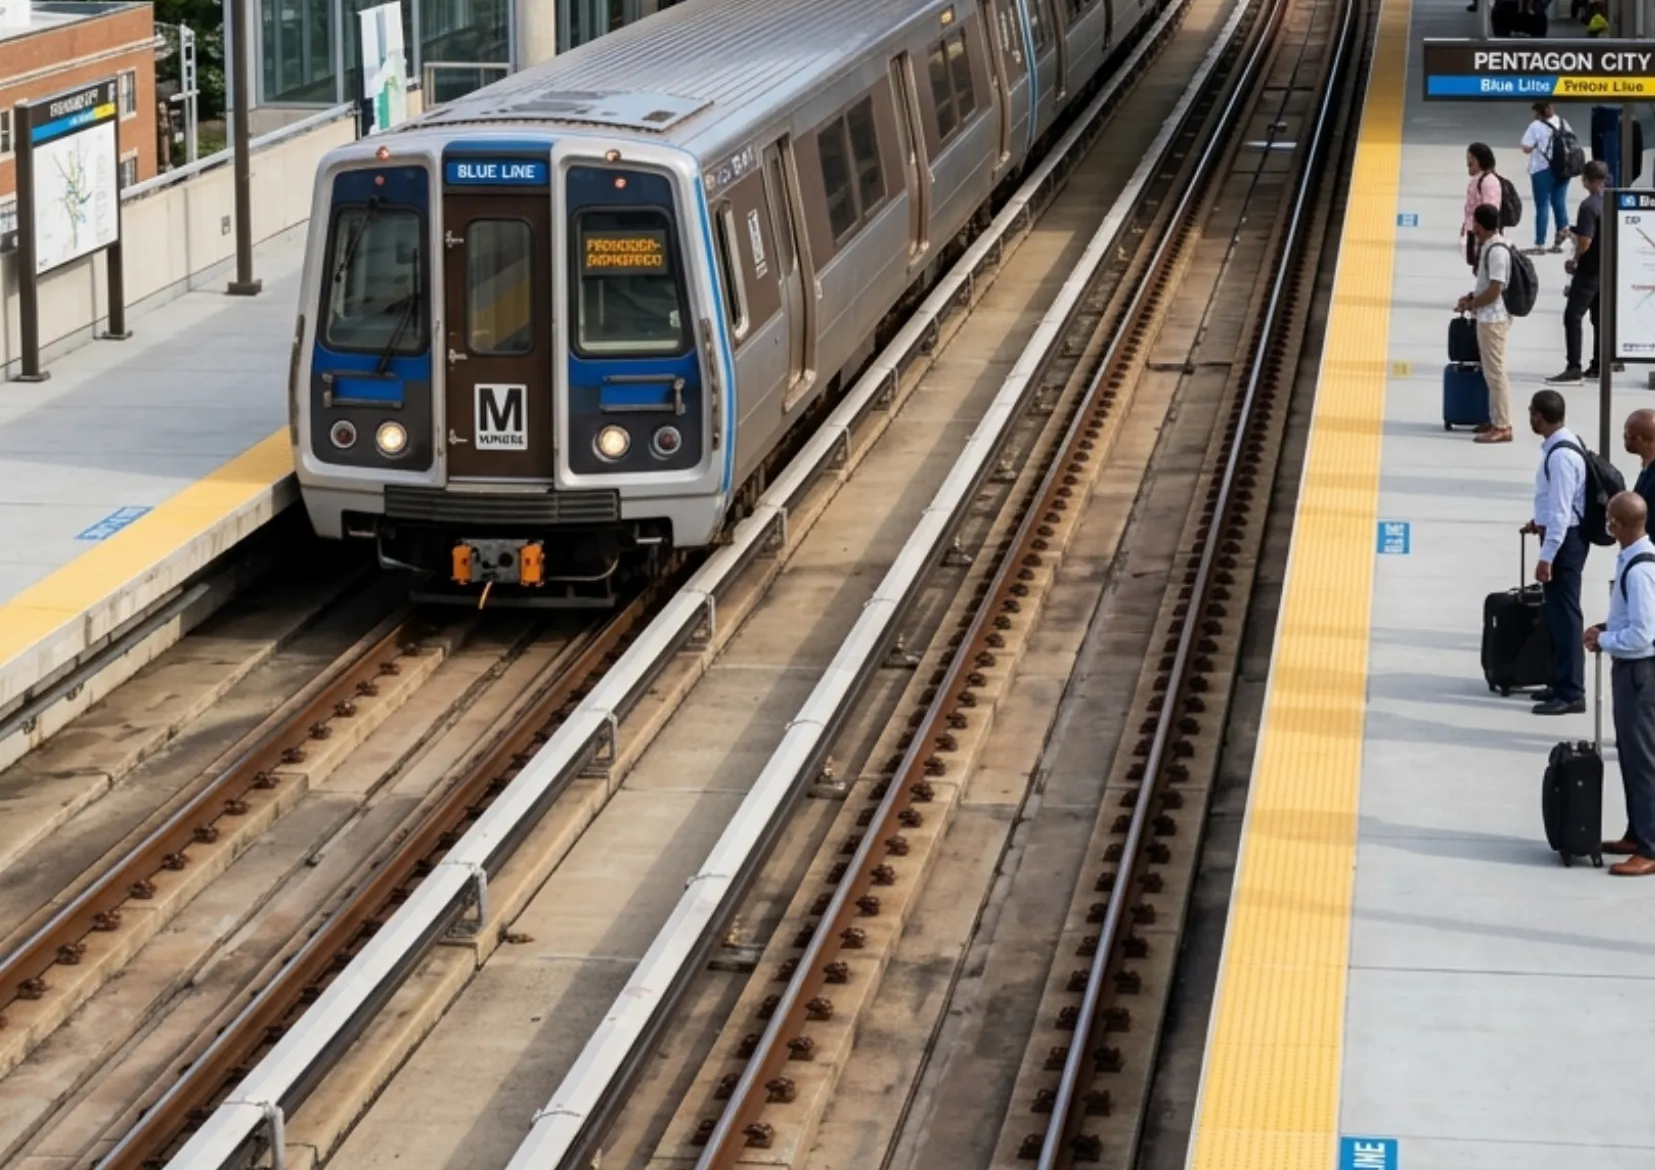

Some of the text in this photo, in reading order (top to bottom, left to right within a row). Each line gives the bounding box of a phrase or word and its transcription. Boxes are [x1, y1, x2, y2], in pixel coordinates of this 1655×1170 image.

[1474, 51, 1651, 71] PENTAGON CITY
[457, 164, 536, 179] BLUE LINE
[479, 387, 523, 432] M
